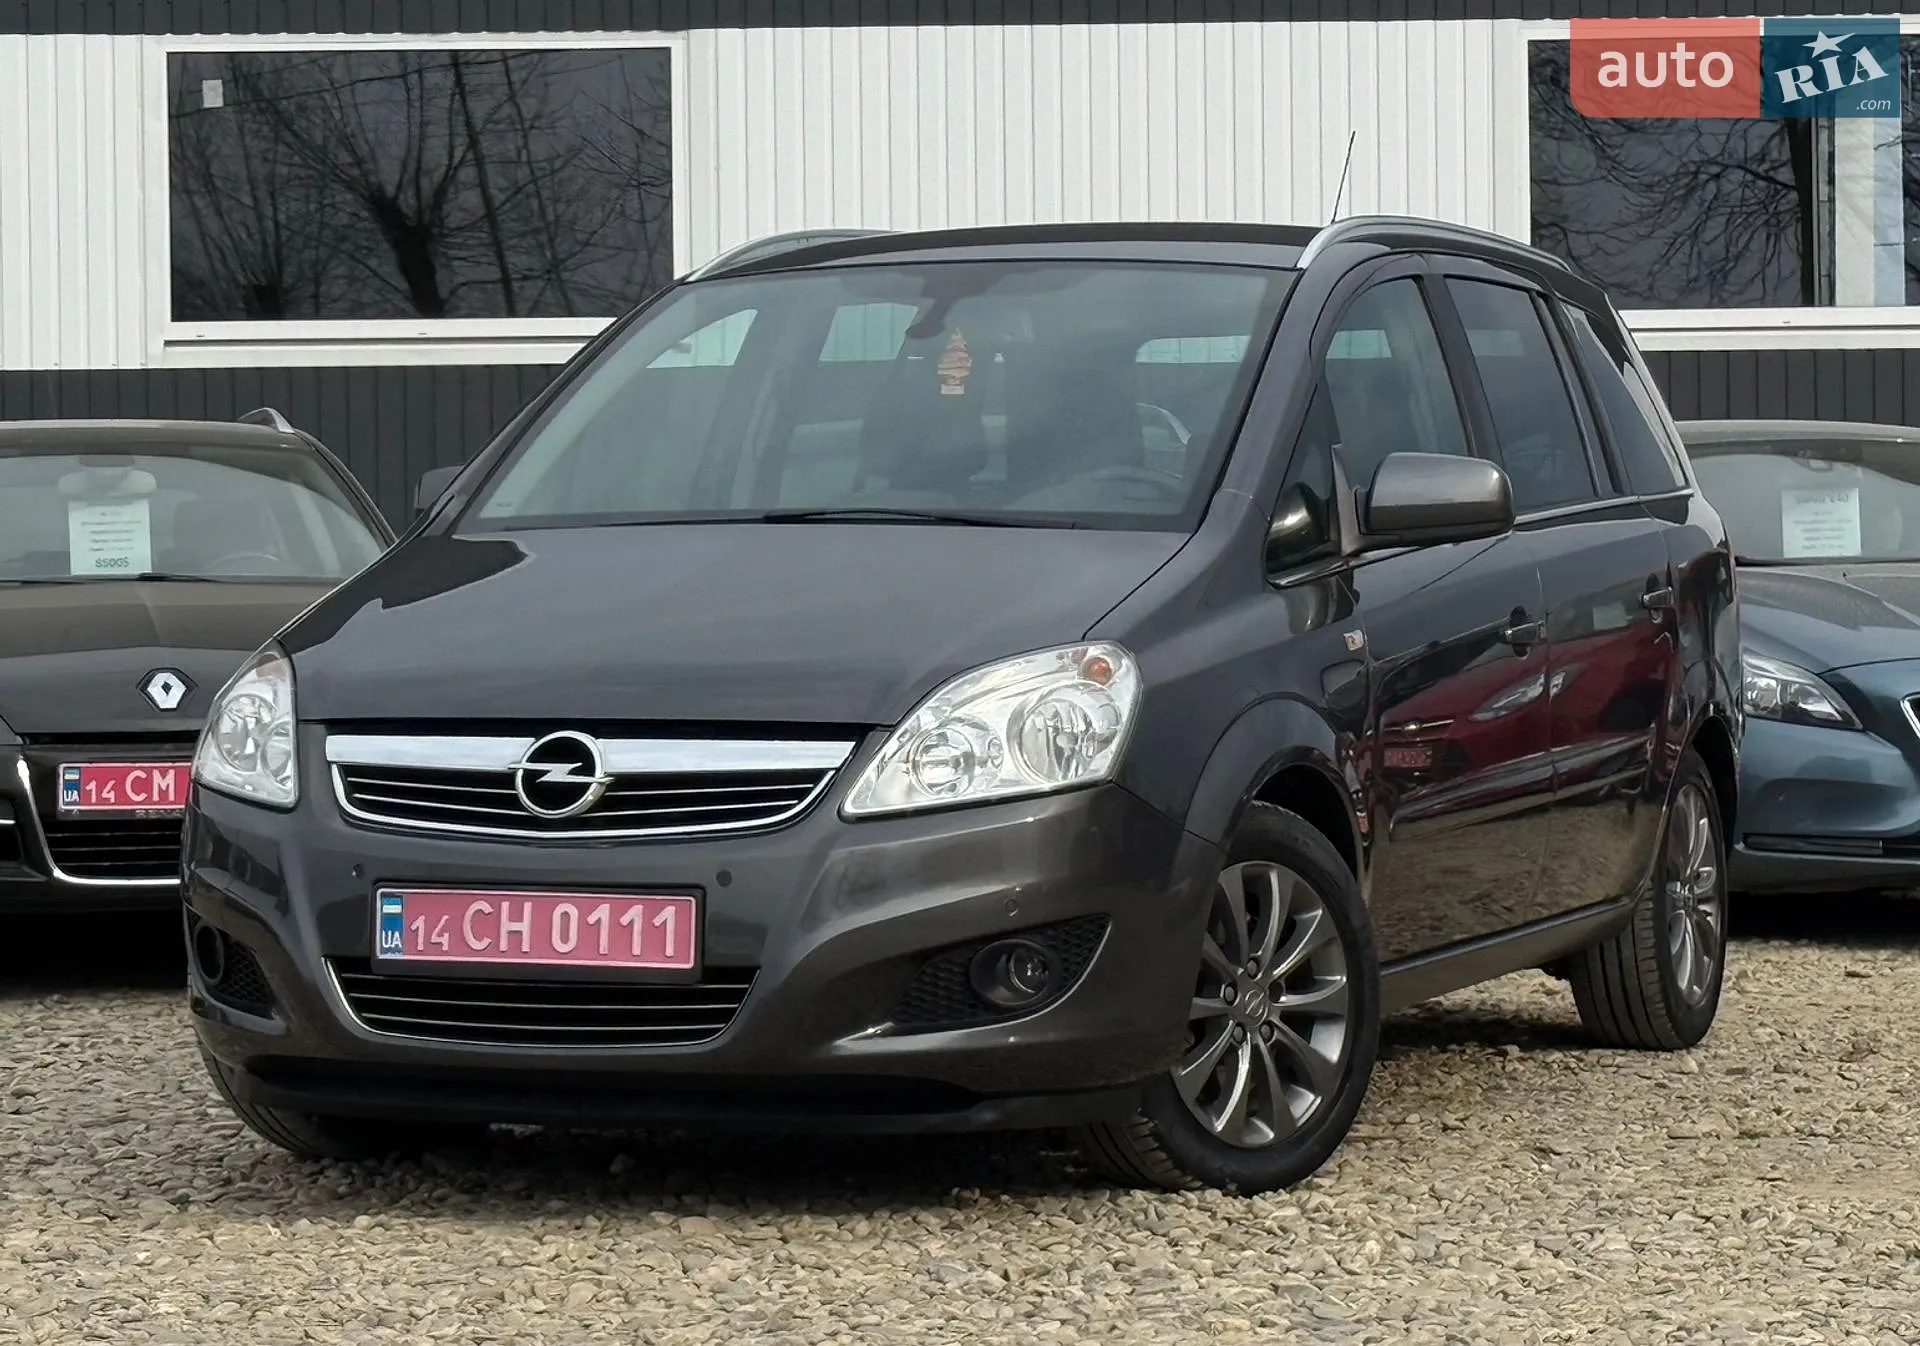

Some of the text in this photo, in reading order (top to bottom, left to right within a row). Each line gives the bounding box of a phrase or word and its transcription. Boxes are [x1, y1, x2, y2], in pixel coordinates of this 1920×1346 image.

[63, 789, 80, 802] UA
[85, 769, 176, 804] 14 CM
[382, 929, 402, 948] UA
[410, 899, 677, 957] 14 CH 0111
